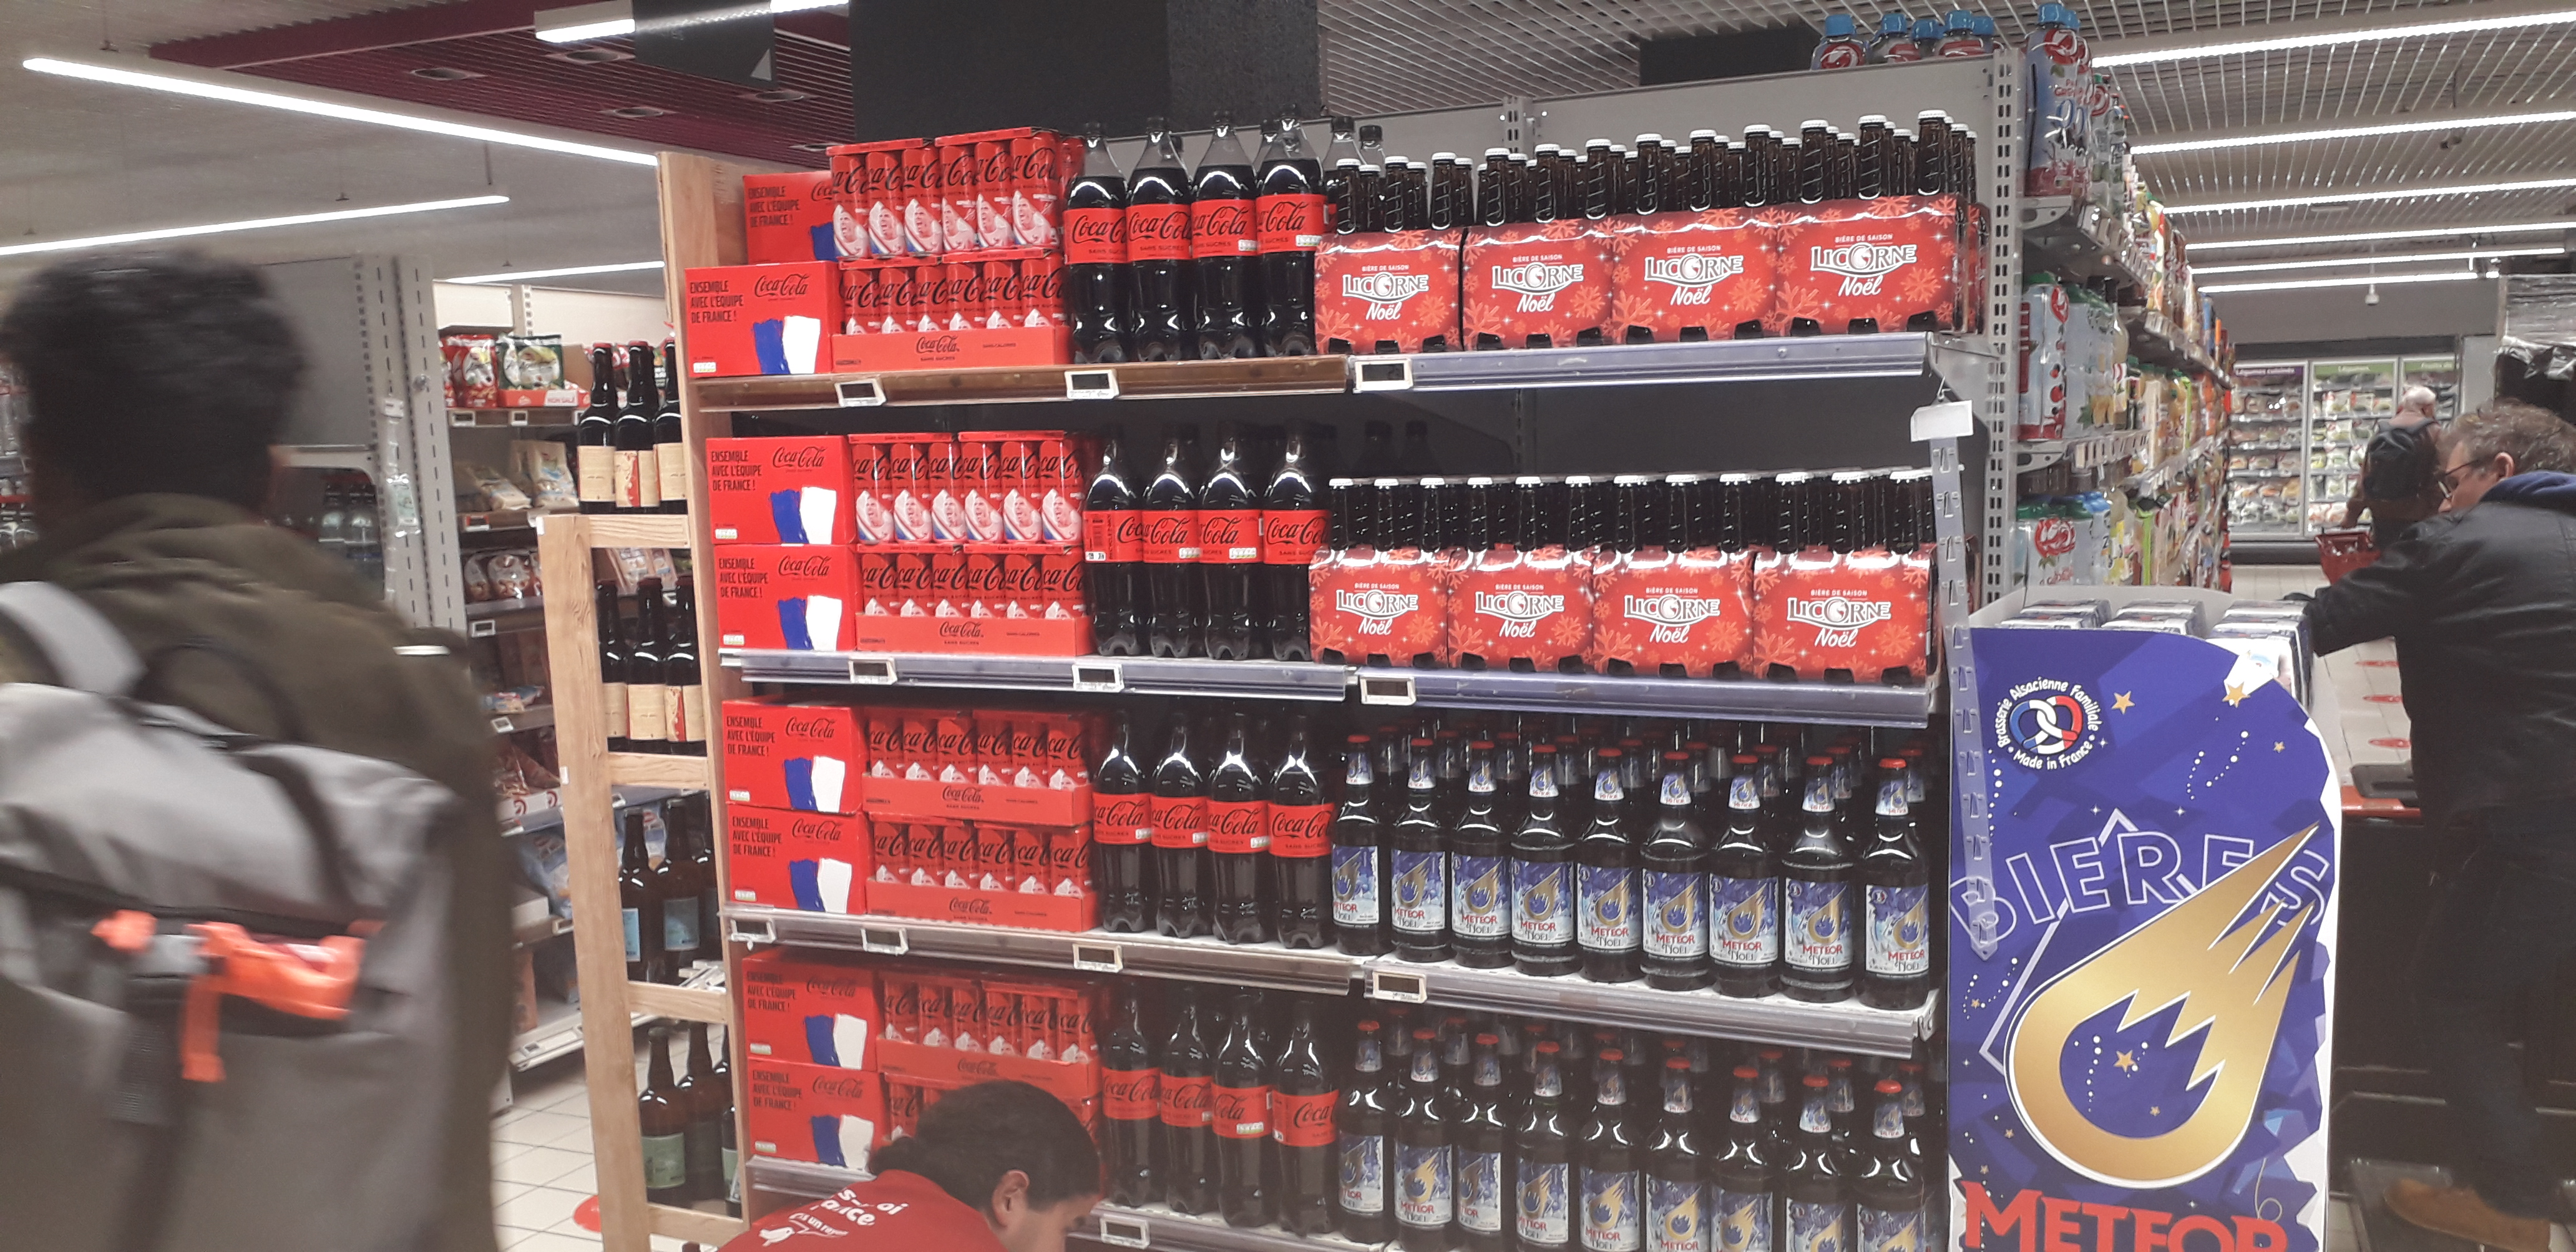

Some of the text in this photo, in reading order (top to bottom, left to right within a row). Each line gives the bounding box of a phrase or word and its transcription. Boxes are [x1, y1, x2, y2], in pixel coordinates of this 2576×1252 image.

[1810, 242, 1918, 271] LICORNE
[1492, 262, 1584, 290] LICORNE
[1644, 253, 1744, 282] LICORNE
[1342, 271, 1429, 300] LICORNE
[1671, 284, 1712, 305] Noël
[1838, 275, 1883, 296] Noël
[1366, 301, 1402, 320] Noël
[1516, 291, 1556, 313] Noël
[1336, 589, 1418, 615] LICORNE
[1475, 590, 1564, 617] LICORNE
[1624, 594, 1720, 622] LICORNE
[1787, 597, 1891, 625] LICORNE
[1358, 617, 1393, 635] Noël
[1499, 620, 1537, 638] Noël
[1649, 625, 1690, 644] Noël
[1814, 628, 1858, 648] Noël
[1995, 677, 2102, 748] Brasserie Alsacienne Familiale
[2013, 741, 2093, 770] Made in France
[1461, 914, 1497, 924] METEOR
[1521, 921, 1556, 931] METEOR
[1591, 926, 1629, 937] METEOR
[1657, 933, 1694, 944] METEOR
[1722, 939, 1762, 951] METEOR
[1803, 944, 1842, 955] METEOR
[1888, 950, 1925, 961] METEOR
